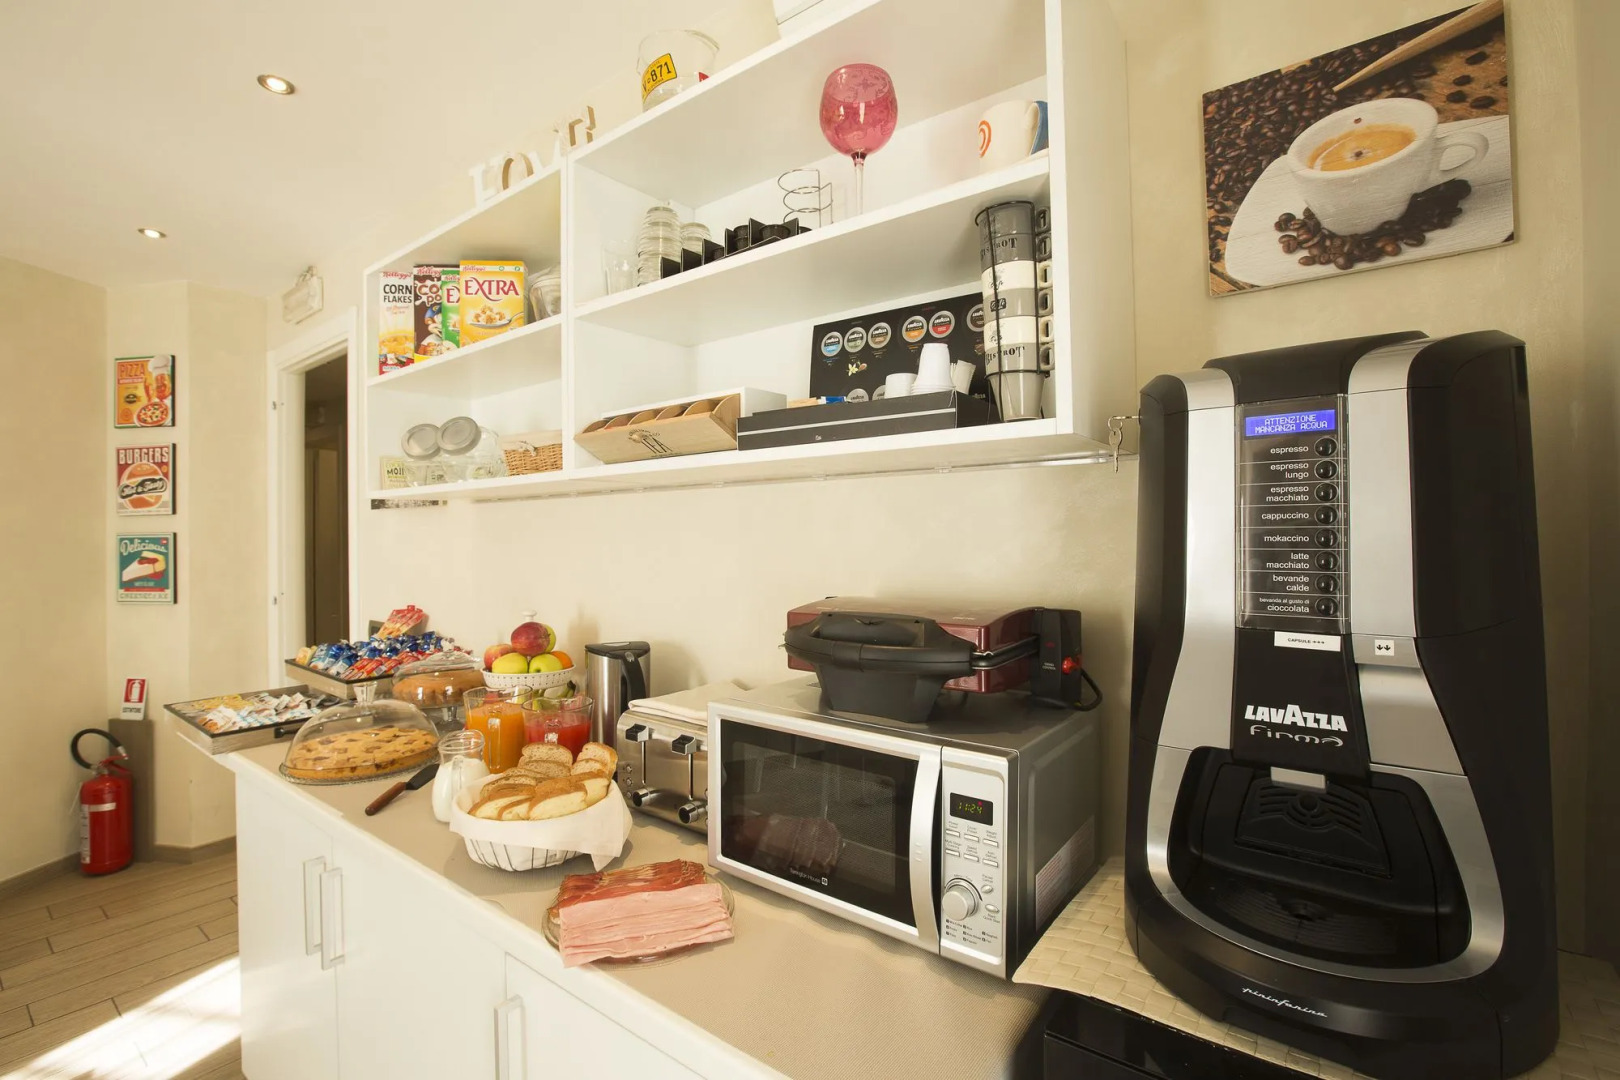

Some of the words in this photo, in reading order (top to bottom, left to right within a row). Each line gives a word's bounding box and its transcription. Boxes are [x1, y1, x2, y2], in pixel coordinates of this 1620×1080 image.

[383, 284, 412, 295] CORN
[465, 277, 520, 302] EXTRA
[384, 295, 412, 303] FLAKES
[119, 363, 144, 378] PIZZA
[1264, 414, 1317, 426] ATTENZIONE
[1254, 424, 1296, 434] MANCANZA
[1300, 421, 1328, 430] ACQUA
[1270, 446, 1309, 454] espresso
[119, 447, 169, 464] BURGERS
[1270, 463, 1309, 471] espresso
[1285, 471, 1309, 480] lungo
[1270, 486, 1309, 494] espresso
[1261, 512, 1309, 521] cappuccino
[1291, 552, 1309, 560] latte
[1273, 574, 1309, 582] bevande
[1286, 584, 1309, 592] calde
[1267, 604, 1310, 613] cioccolata
[1244, 704, 1348, 732] LAVAZZA
